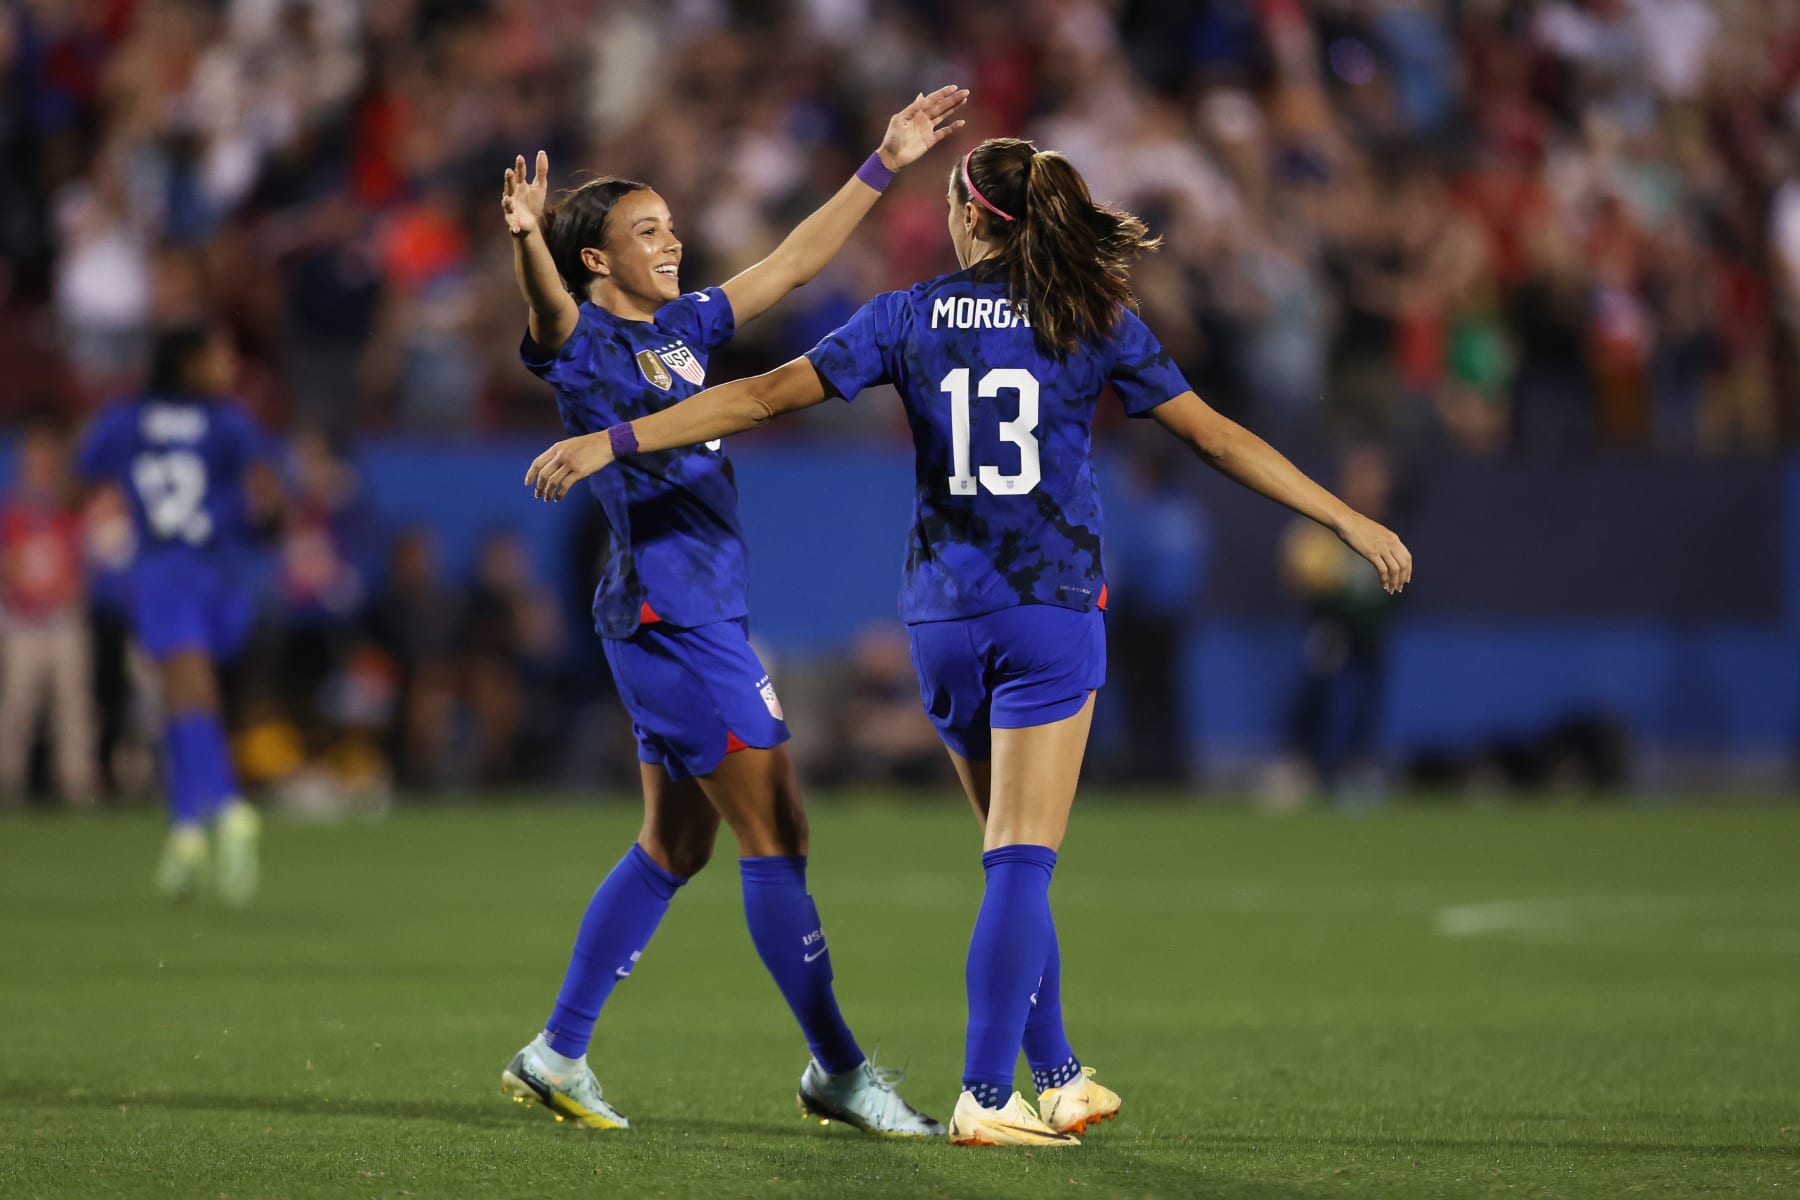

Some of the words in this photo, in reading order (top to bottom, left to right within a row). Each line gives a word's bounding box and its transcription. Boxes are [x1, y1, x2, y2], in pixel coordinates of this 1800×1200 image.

[931, 296, 1031, 329] MORGA
[662, 349, 691, 367] USA
[940, 367, 1041, 496] 13
